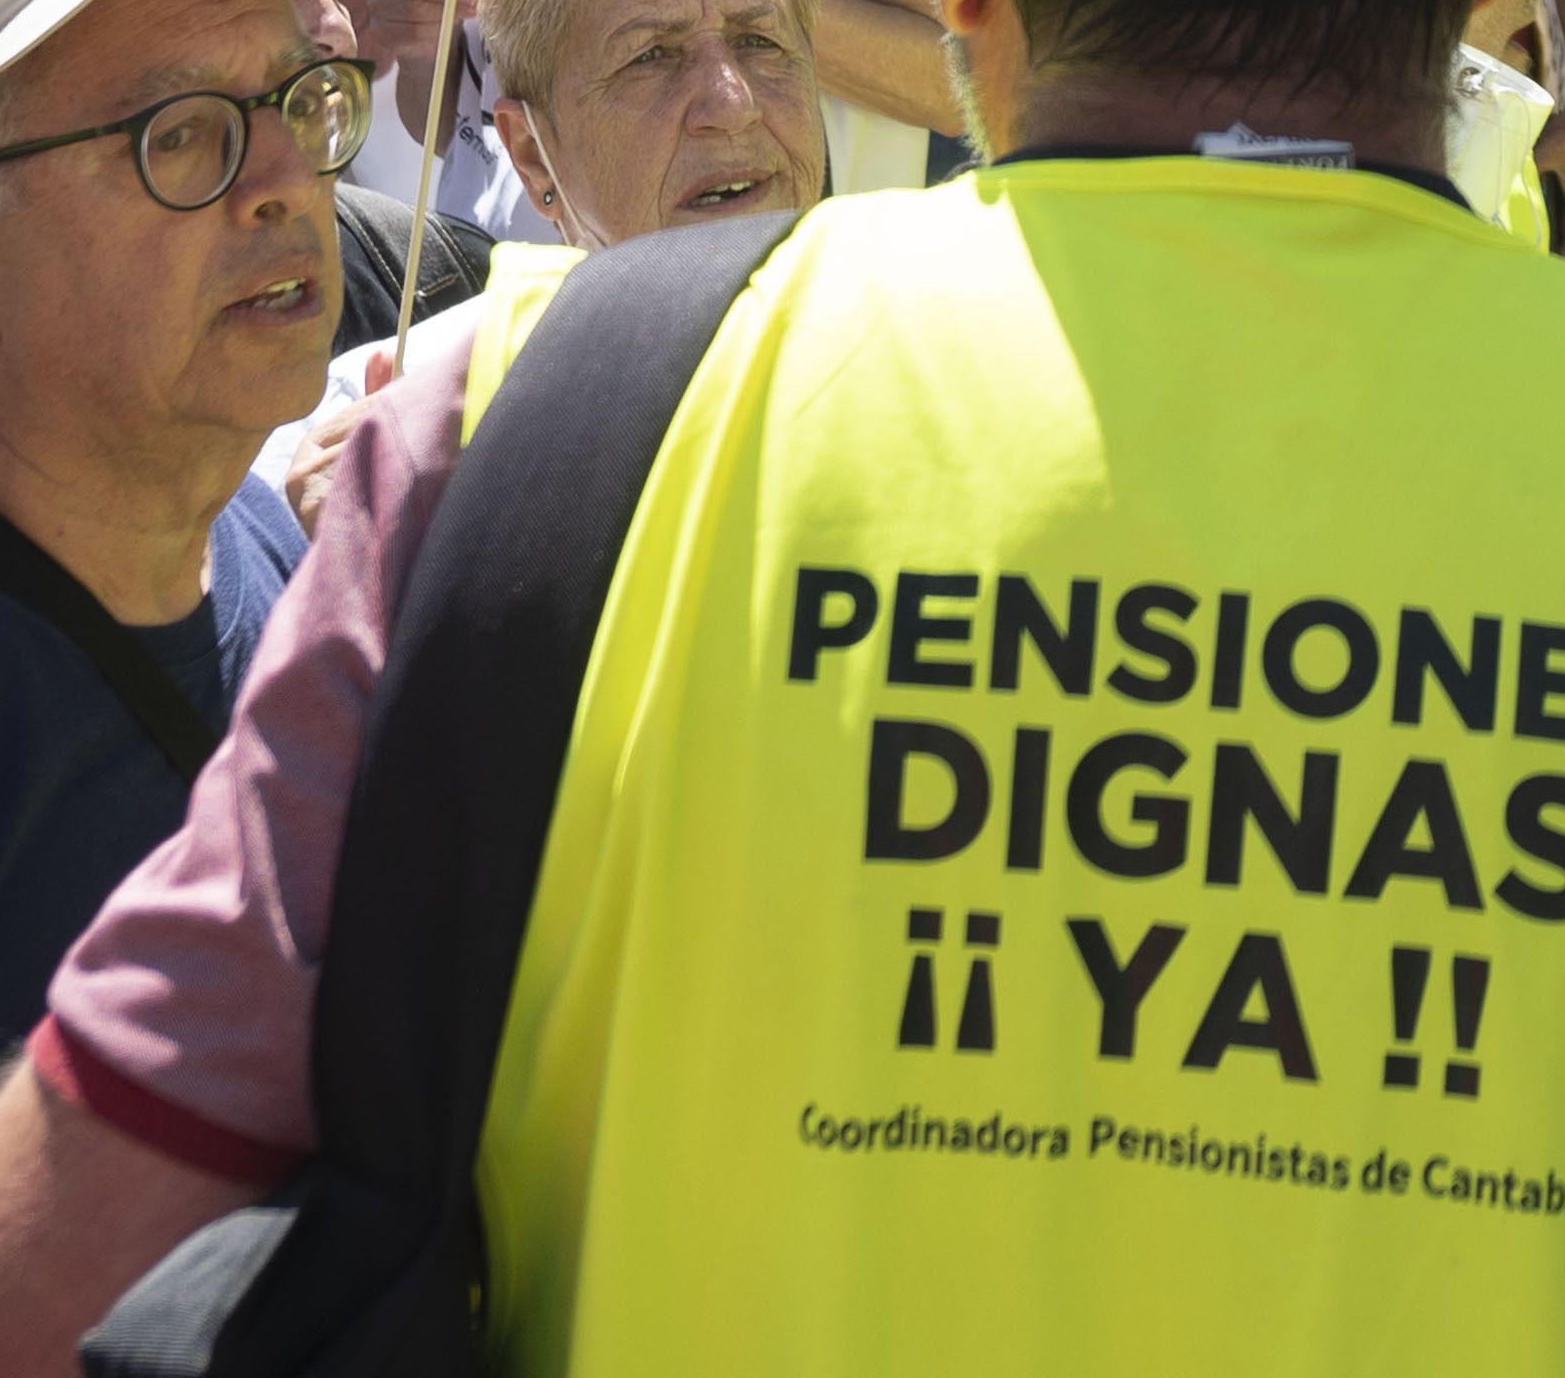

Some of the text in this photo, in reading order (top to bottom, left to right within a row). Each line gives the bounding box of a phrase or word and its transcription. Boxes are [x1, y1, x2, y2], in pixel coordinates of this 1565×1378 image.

[1063, 915, 1322, 1086] YA
[1380, 945, 1493, 1100] !!
[799, 1101, 1071, 1159] Coordinadora
[1087, 1115, 1351, 1191] Pensionistas
[1359, 1148, 1411, 1196] de
